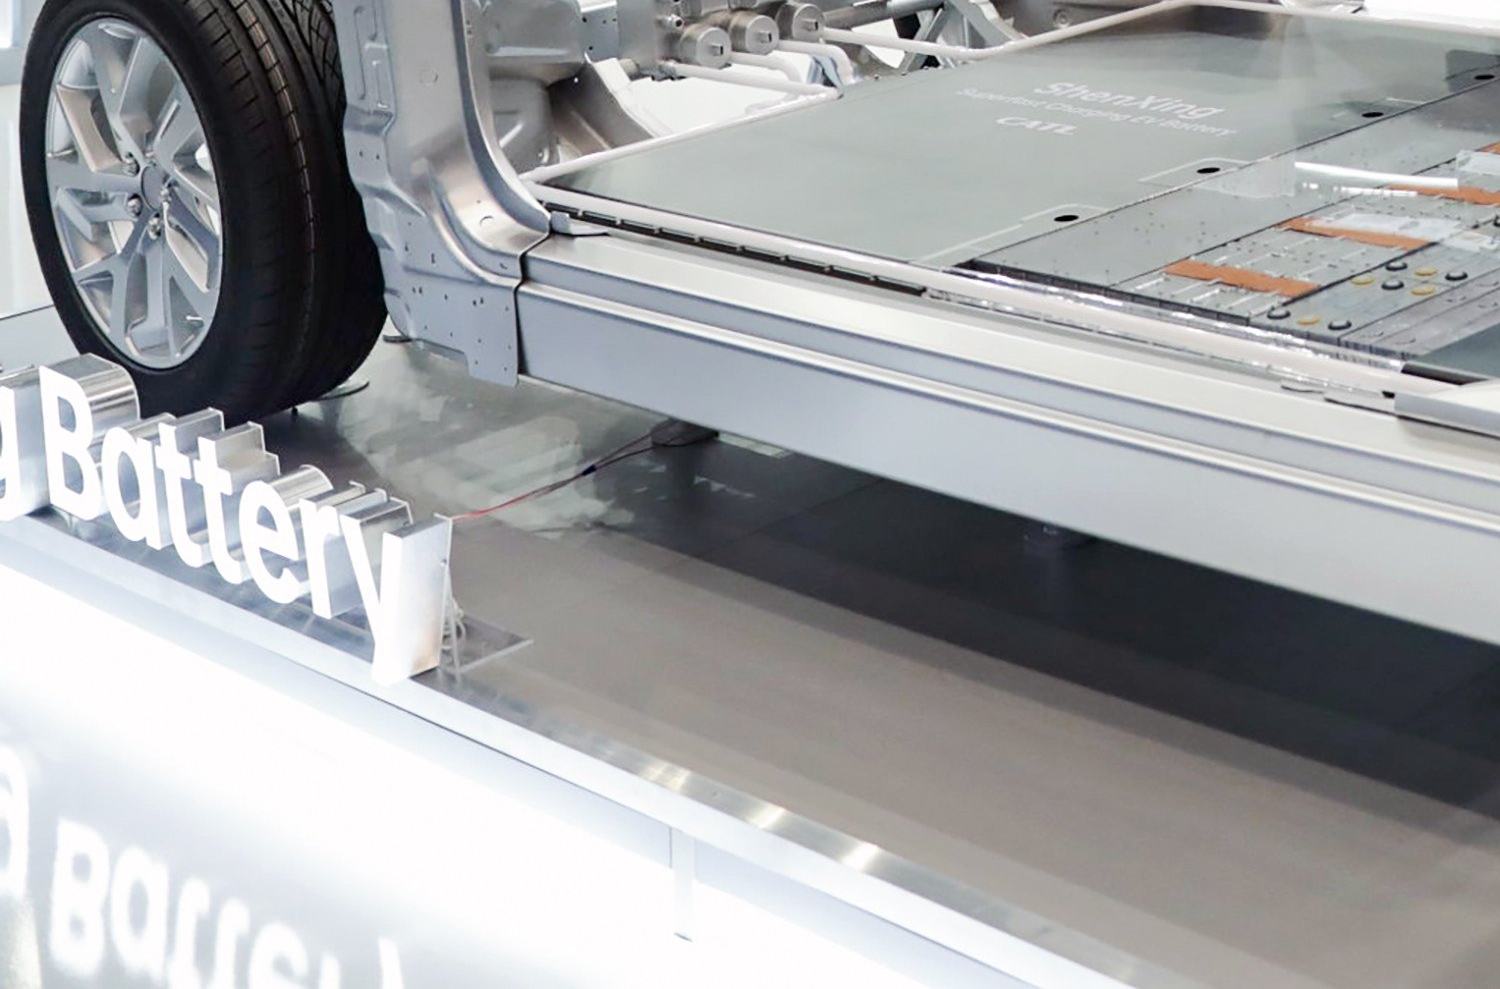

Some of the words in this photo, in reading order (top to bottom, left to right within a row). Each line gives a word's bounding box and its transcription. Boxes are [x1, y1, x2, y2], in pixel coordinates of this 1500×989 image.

[1033, 81, 1226, 120] ShenXing
[996, 115, 1078, 136] CATL
[39, 364, 403, 688] Battery
